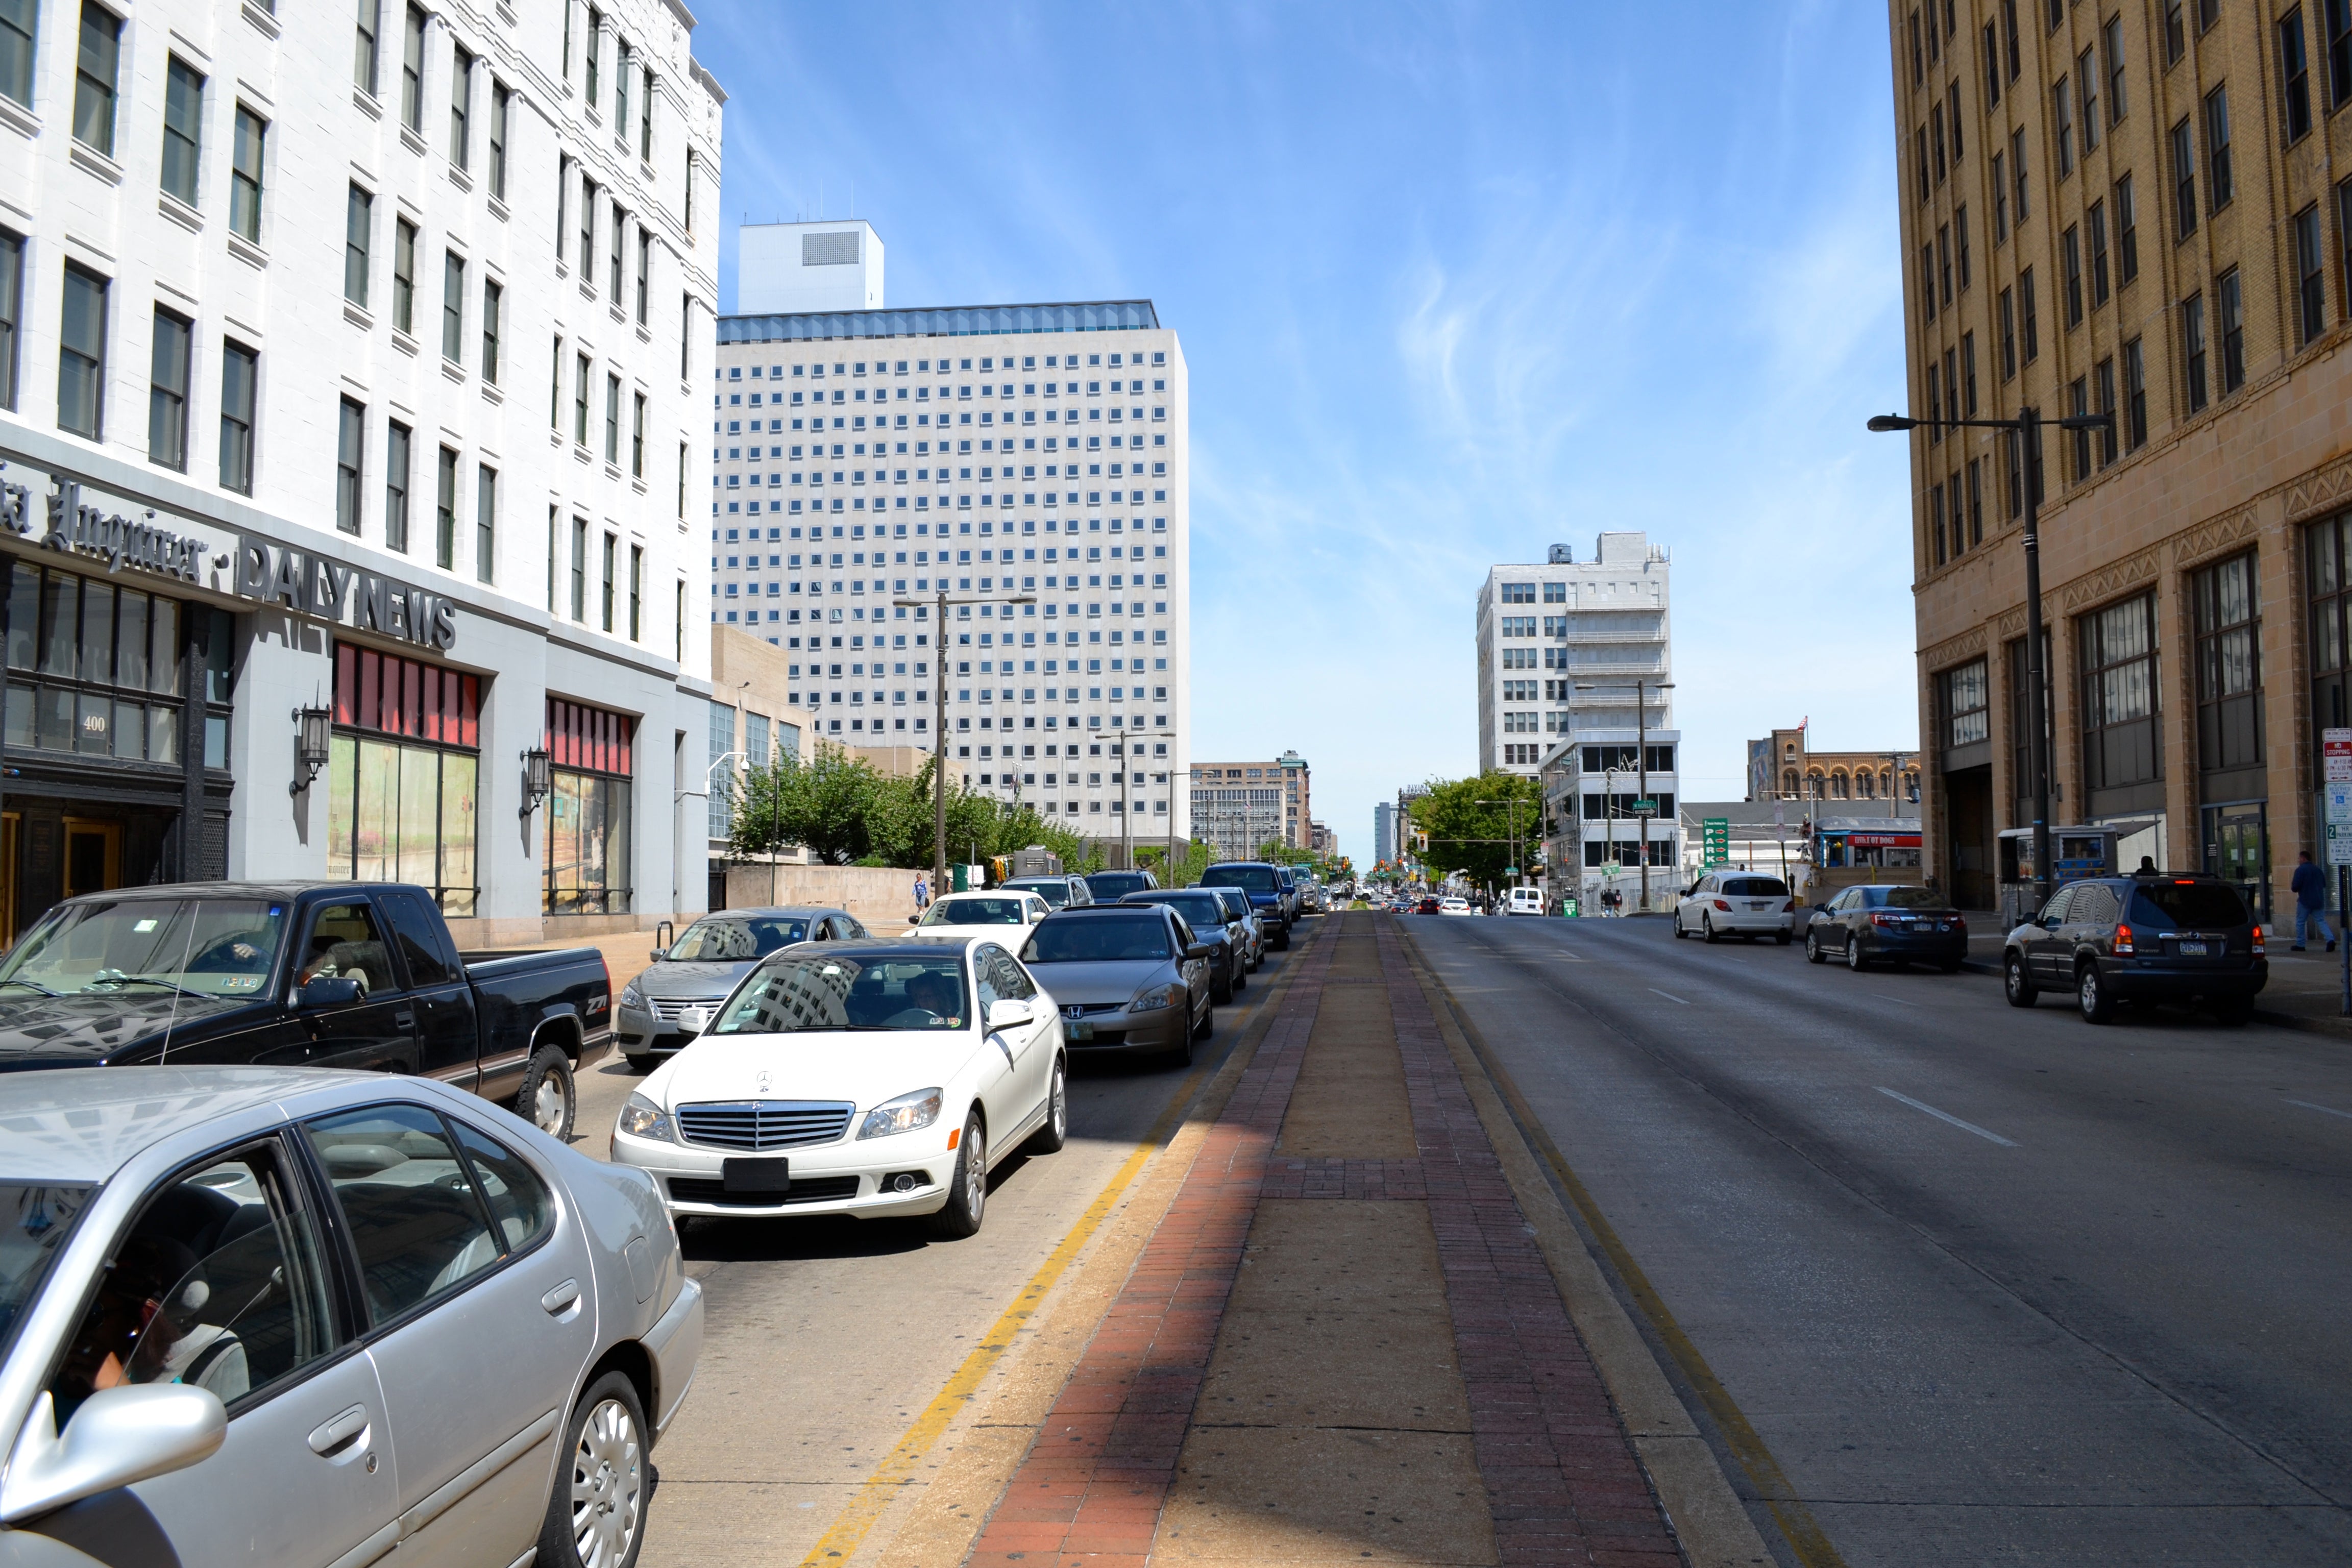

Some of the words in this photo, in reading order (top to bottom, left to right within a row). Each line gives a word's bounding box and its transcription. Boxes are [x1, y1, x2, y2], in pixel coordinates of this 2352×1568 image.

[40, 475, 208, 581] Inquirer
[237, 534, 353, 620] DAILY
[357, 573, 456, 650] NEWS
[84, 716, 105, 731] 400
[2329, 827, 2334, 837] 2
[586, 994, 607, 1016] Z71
